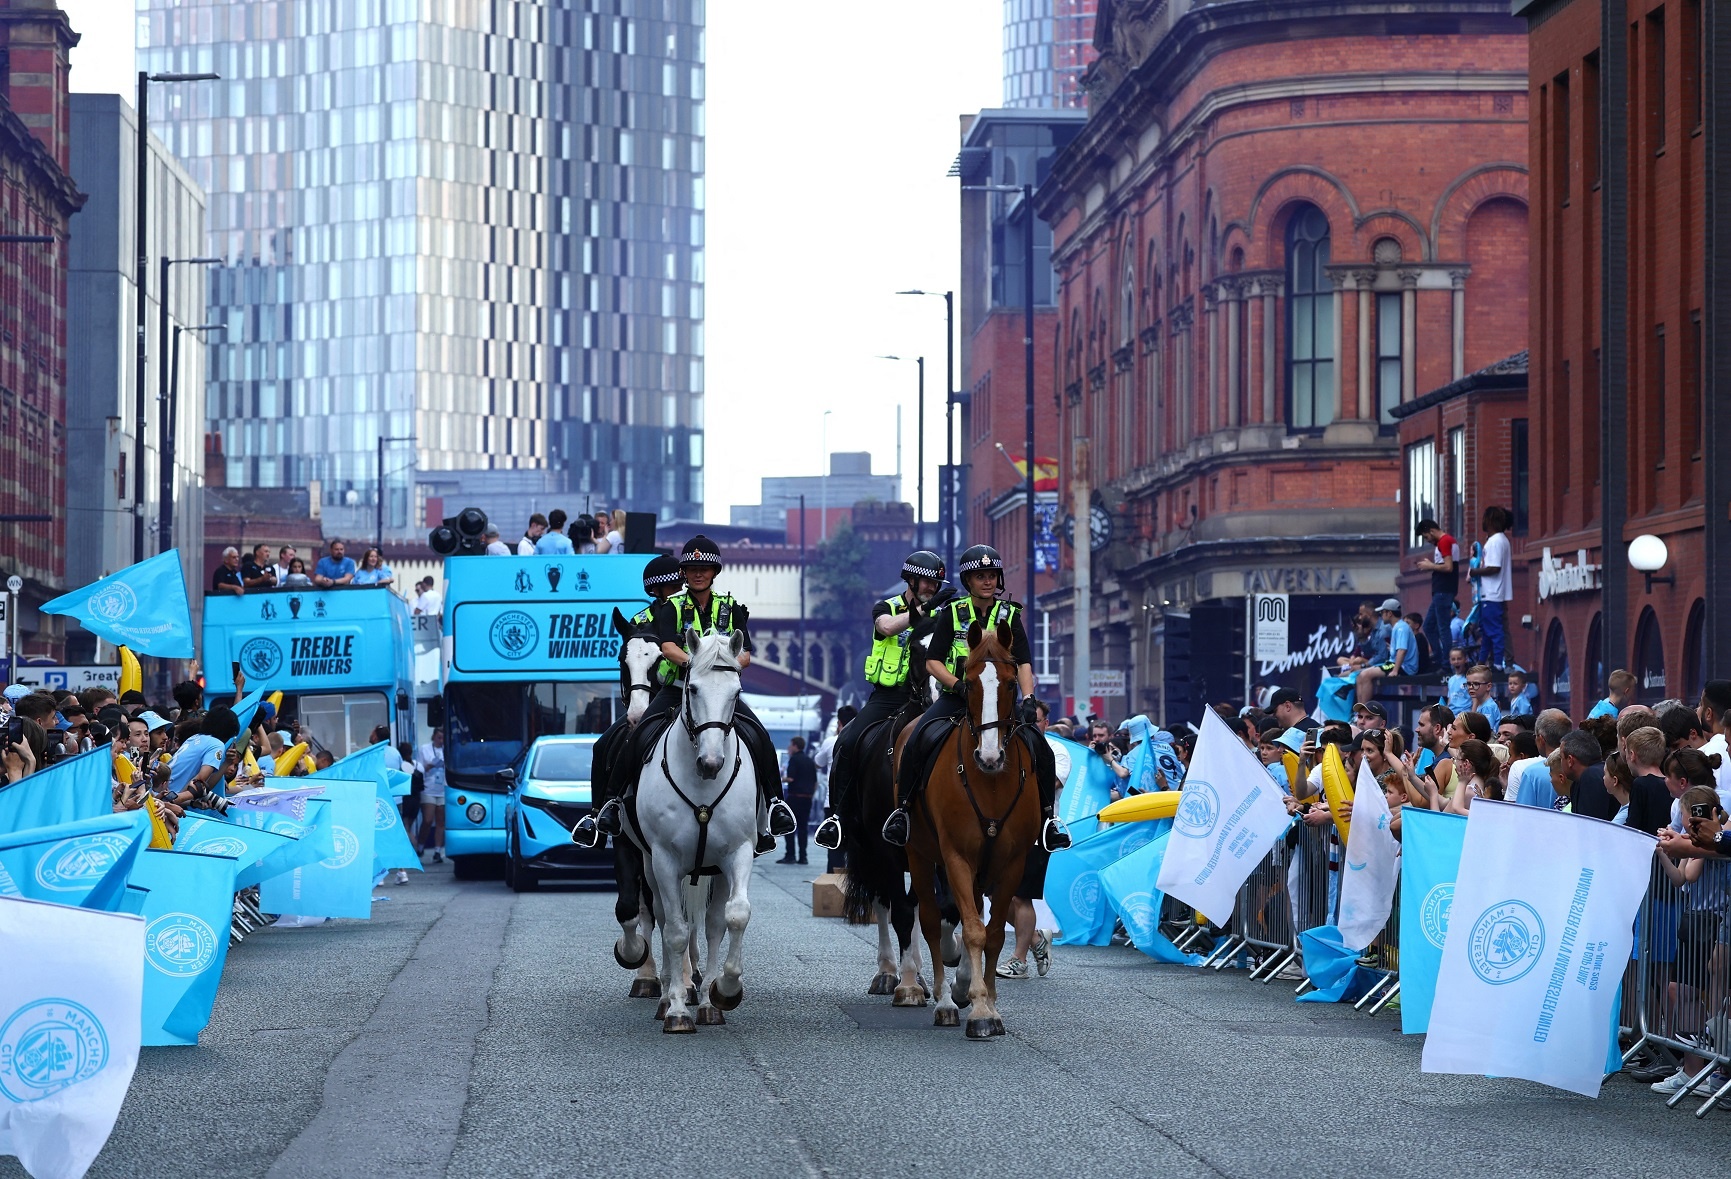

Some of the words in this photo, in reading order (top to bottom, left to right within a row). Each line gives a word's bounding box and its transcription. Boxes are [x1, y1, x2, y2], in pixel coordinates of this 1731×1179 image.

[1243, 566, 1355, 592] TAVERNA
[495, 614, 534, 630] MANCHESTER
[244, 640, 278, 655] MANCHESTER
[291, 635, 354, 660] TREBLE
[548, 640, 619, 659] WINNERS
[1260, 624, 1355, 677] Dimitris
[83, 670, 118, 680] Great
[291, 658, 352, 676] WINNERS
[1159, 756, 1178, 780] 9
[44, 869, 60, 882] CITY
[147, 934, 156, 953] CITY
[188, 920, 212, 970] MANCHESTER
[65, 1010, 99, 1076] MANCHES
[2, 1044, 12, 1076] CITY
